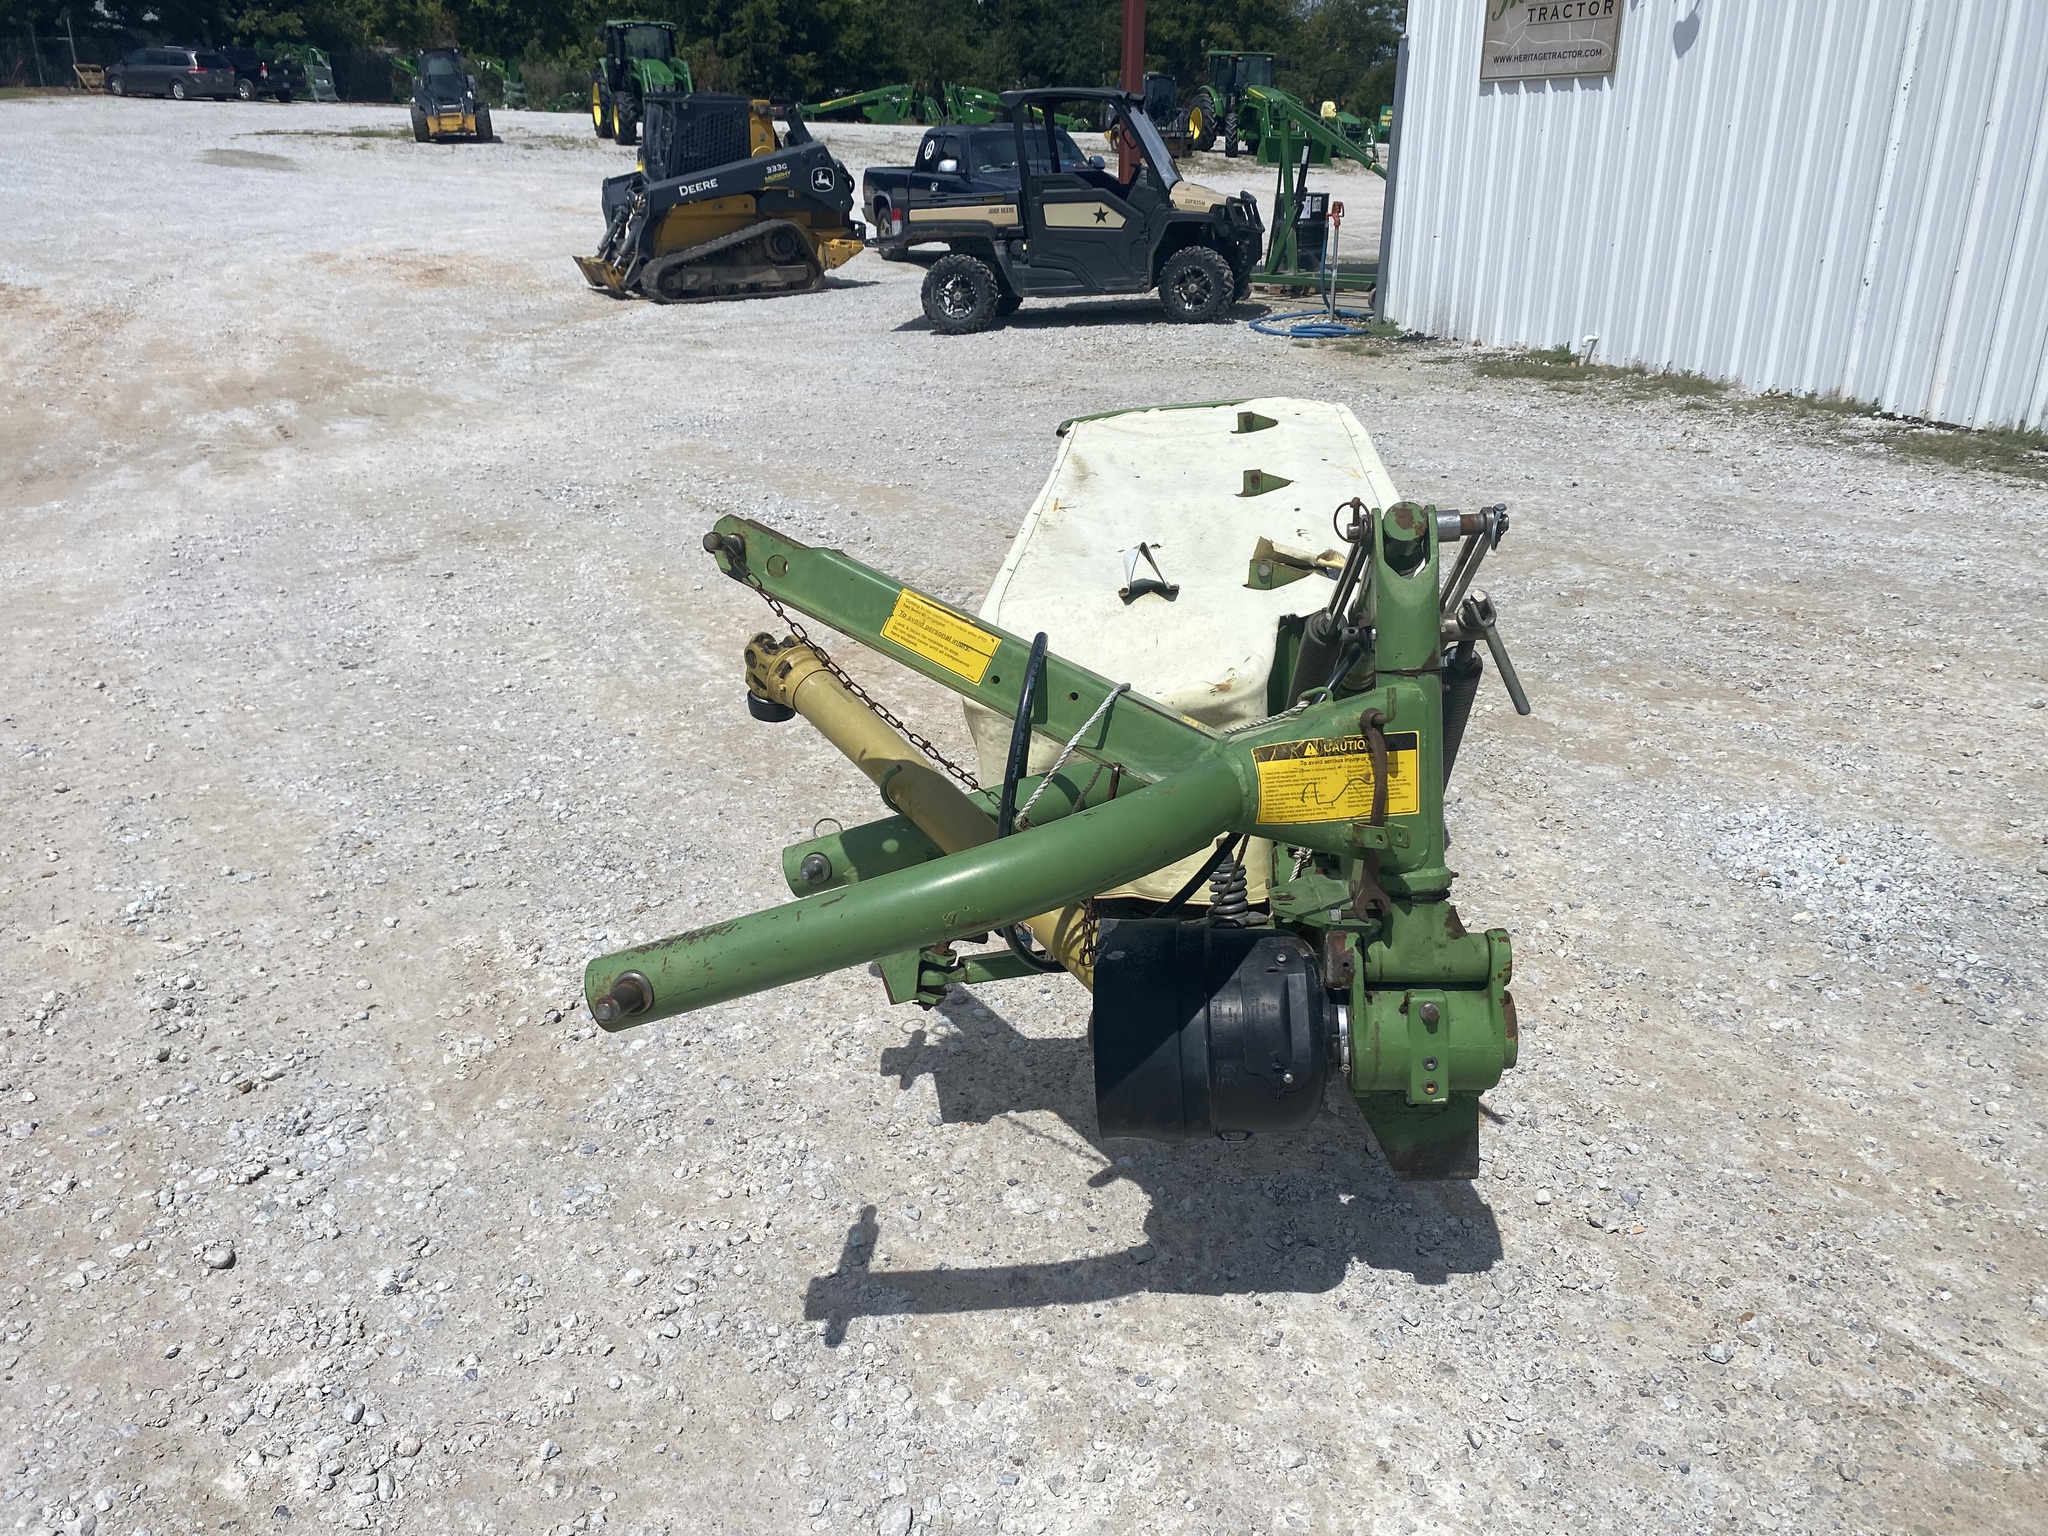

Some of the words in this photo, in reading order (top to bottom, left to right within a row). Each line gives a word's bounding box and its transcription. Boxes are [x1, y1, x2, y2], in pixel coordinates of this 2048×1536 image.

[1528, 0, 1613, 22] TRACTOR
[1493, 48, 1602, 63] WWW.HERITAGETRACTOR.COM
[766, 163, 787, 174] 333G
[679, 178, 718, 196] DEERE
[908, 614, 925, 626] avoid
[926, 624, 952, 641] personal
[1324, 740, 1365, 752] CAUTIO
[1308, 758, 1323, 766] avoid
[1324, 757, 1343, 765] serious
